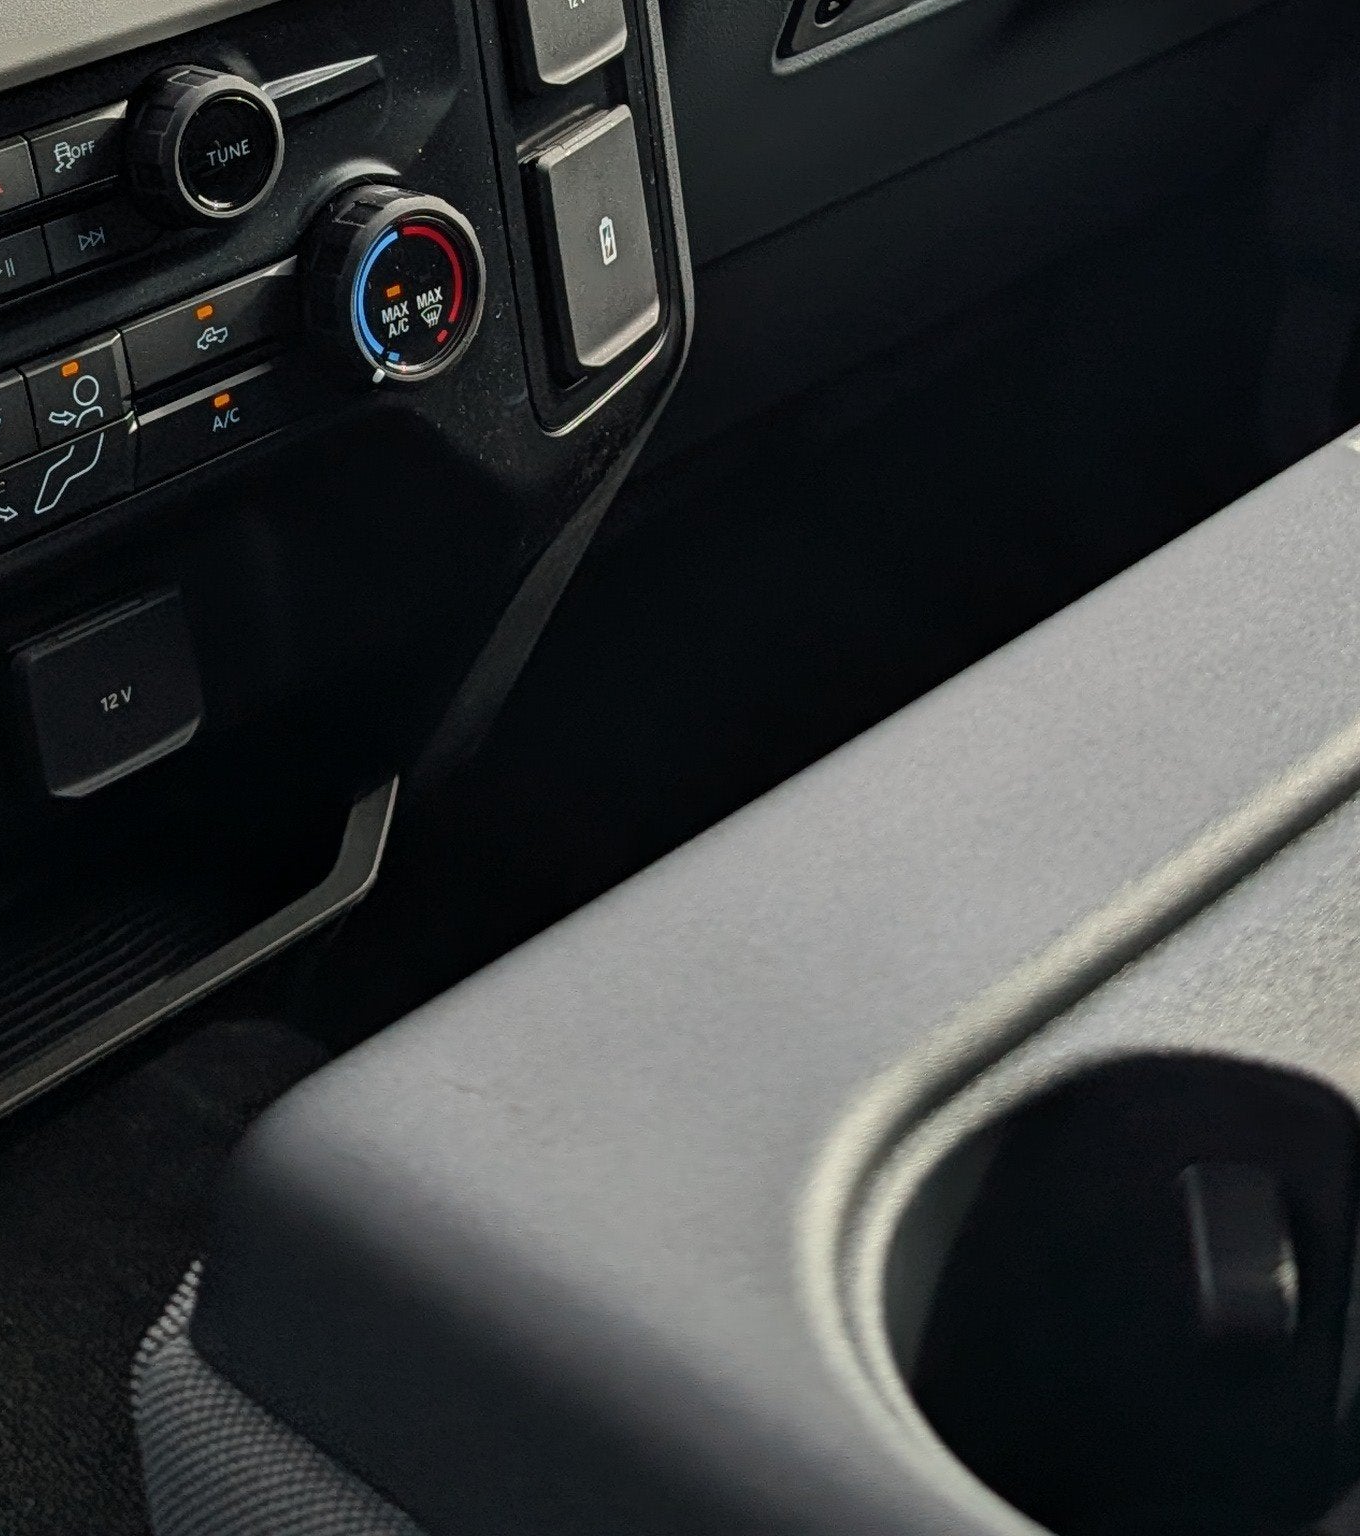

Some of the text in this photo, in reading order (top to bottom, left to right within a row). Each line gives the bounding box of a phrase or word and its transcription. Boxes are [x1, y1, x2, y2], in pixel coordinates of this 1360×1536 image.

[70, 140, 96, 160] OFF
[206, 139, 251, 166] TUNE
[416, 286, 443, 310] MAX
[381, 300, 410, 324] MAX
[388, 317, 410, 339] A/C
[212, 407, 240, 432] A/C
